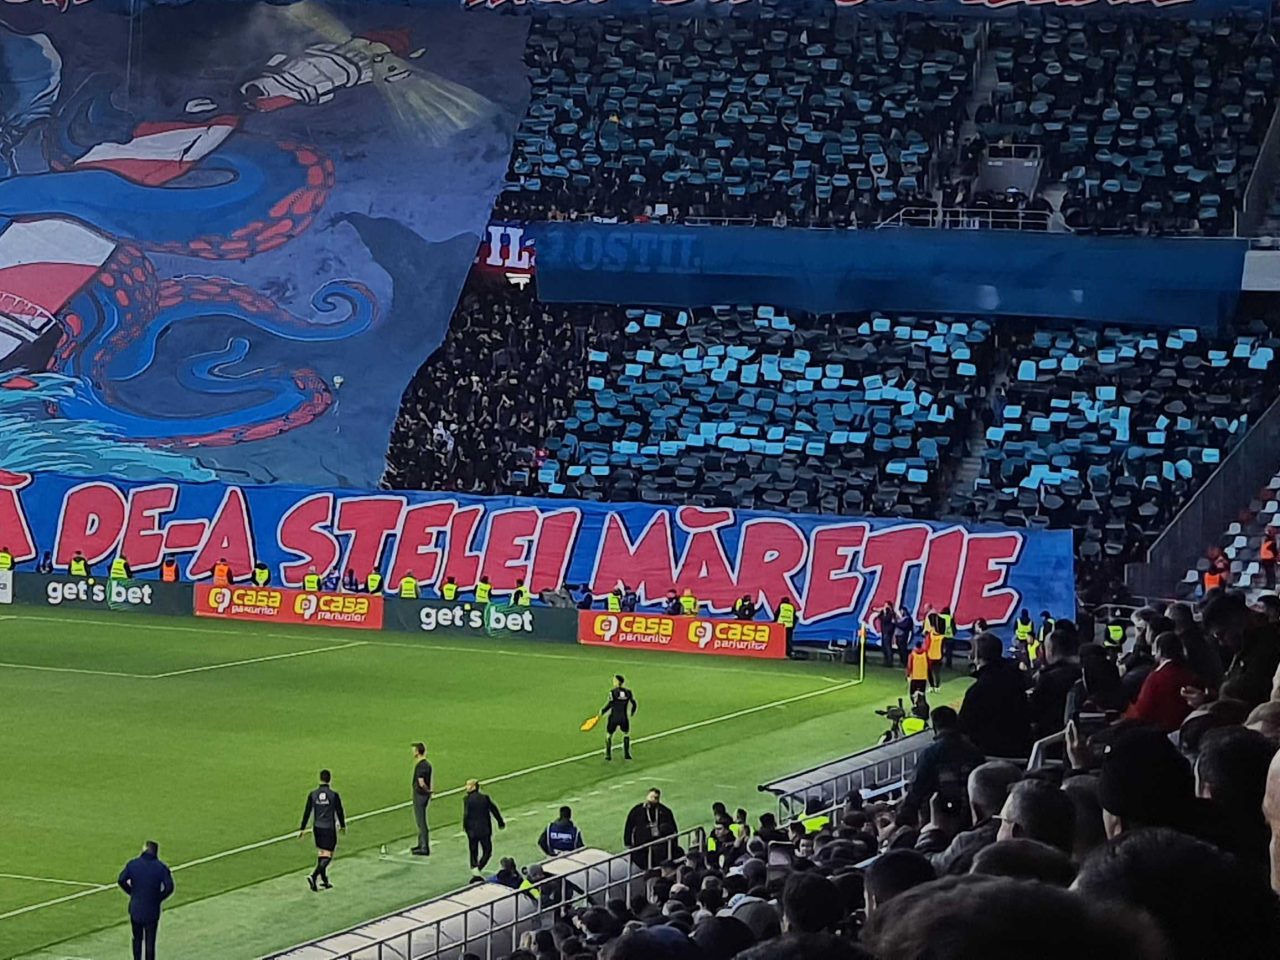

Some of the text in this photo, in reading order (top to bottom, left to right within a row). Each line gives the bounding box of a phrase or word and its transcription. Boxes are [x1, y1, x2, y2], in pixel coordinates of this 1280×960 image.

[53, 483, 256, 581] DE-A
[278, 493, 580, 596] STELEI
[47, 578, 152, 604] get's bet
[232, 589, 281, 607] casa
[320, 596, 369, 614] casa
[420, 603, 532, 631] get's bet
[620, 616, 674, 635] casa
[715, 622, 770, 641] casa
